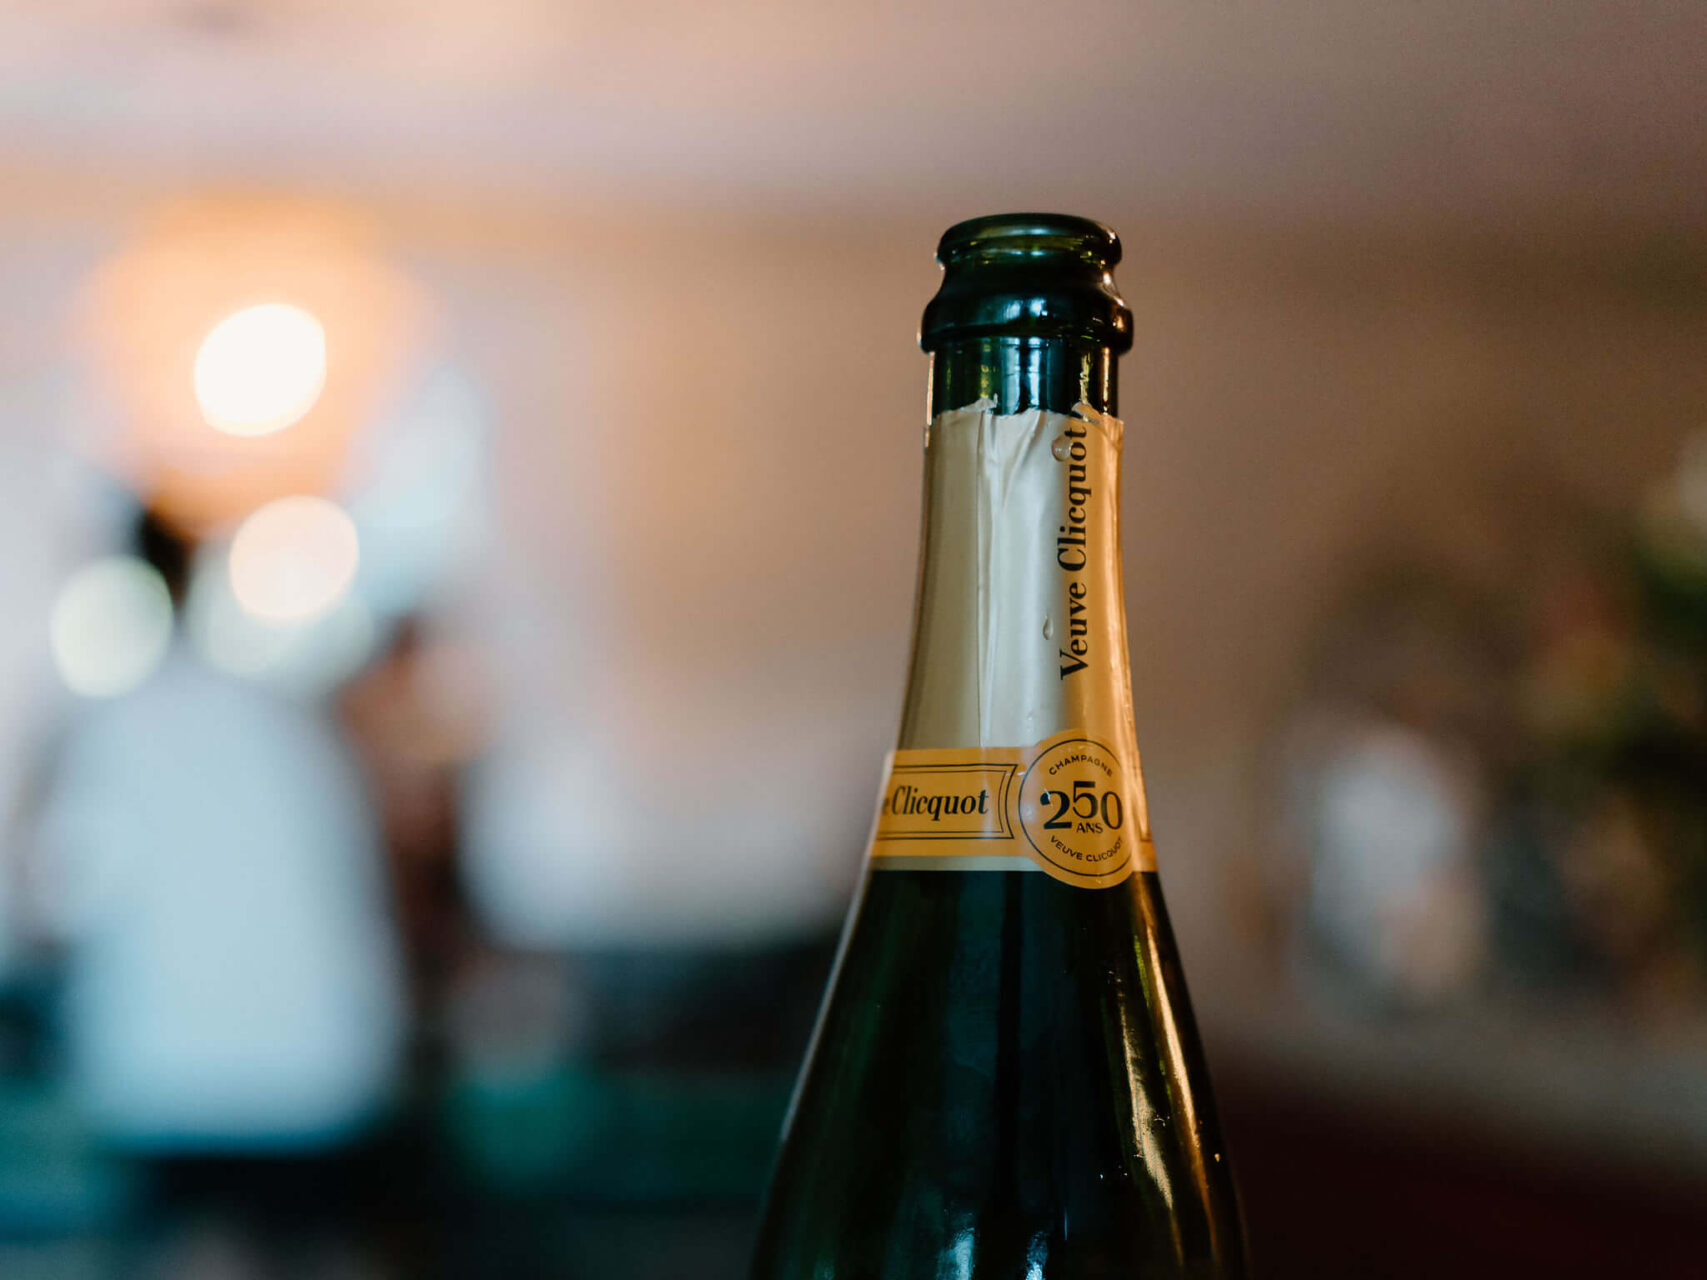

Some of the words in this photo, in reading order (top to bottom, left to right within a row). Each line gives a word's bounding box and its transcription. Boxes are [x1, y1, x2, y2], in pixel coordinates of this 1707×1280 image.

[1057, 426, 1092, 572] Clicquot
[1059, 582, 1089, 680] Veuve
[1048, 754, 1113, 777] CHAMPAGNE
[892, 785, 989, 821] Clicquot
[1040, 780, 1123, 830] 250
[1076, 822, 1103, 834] ANS
[1051, 835, 1083, 860] VEUVE
[1085, 836, 1123, 862] CLICQUOT
